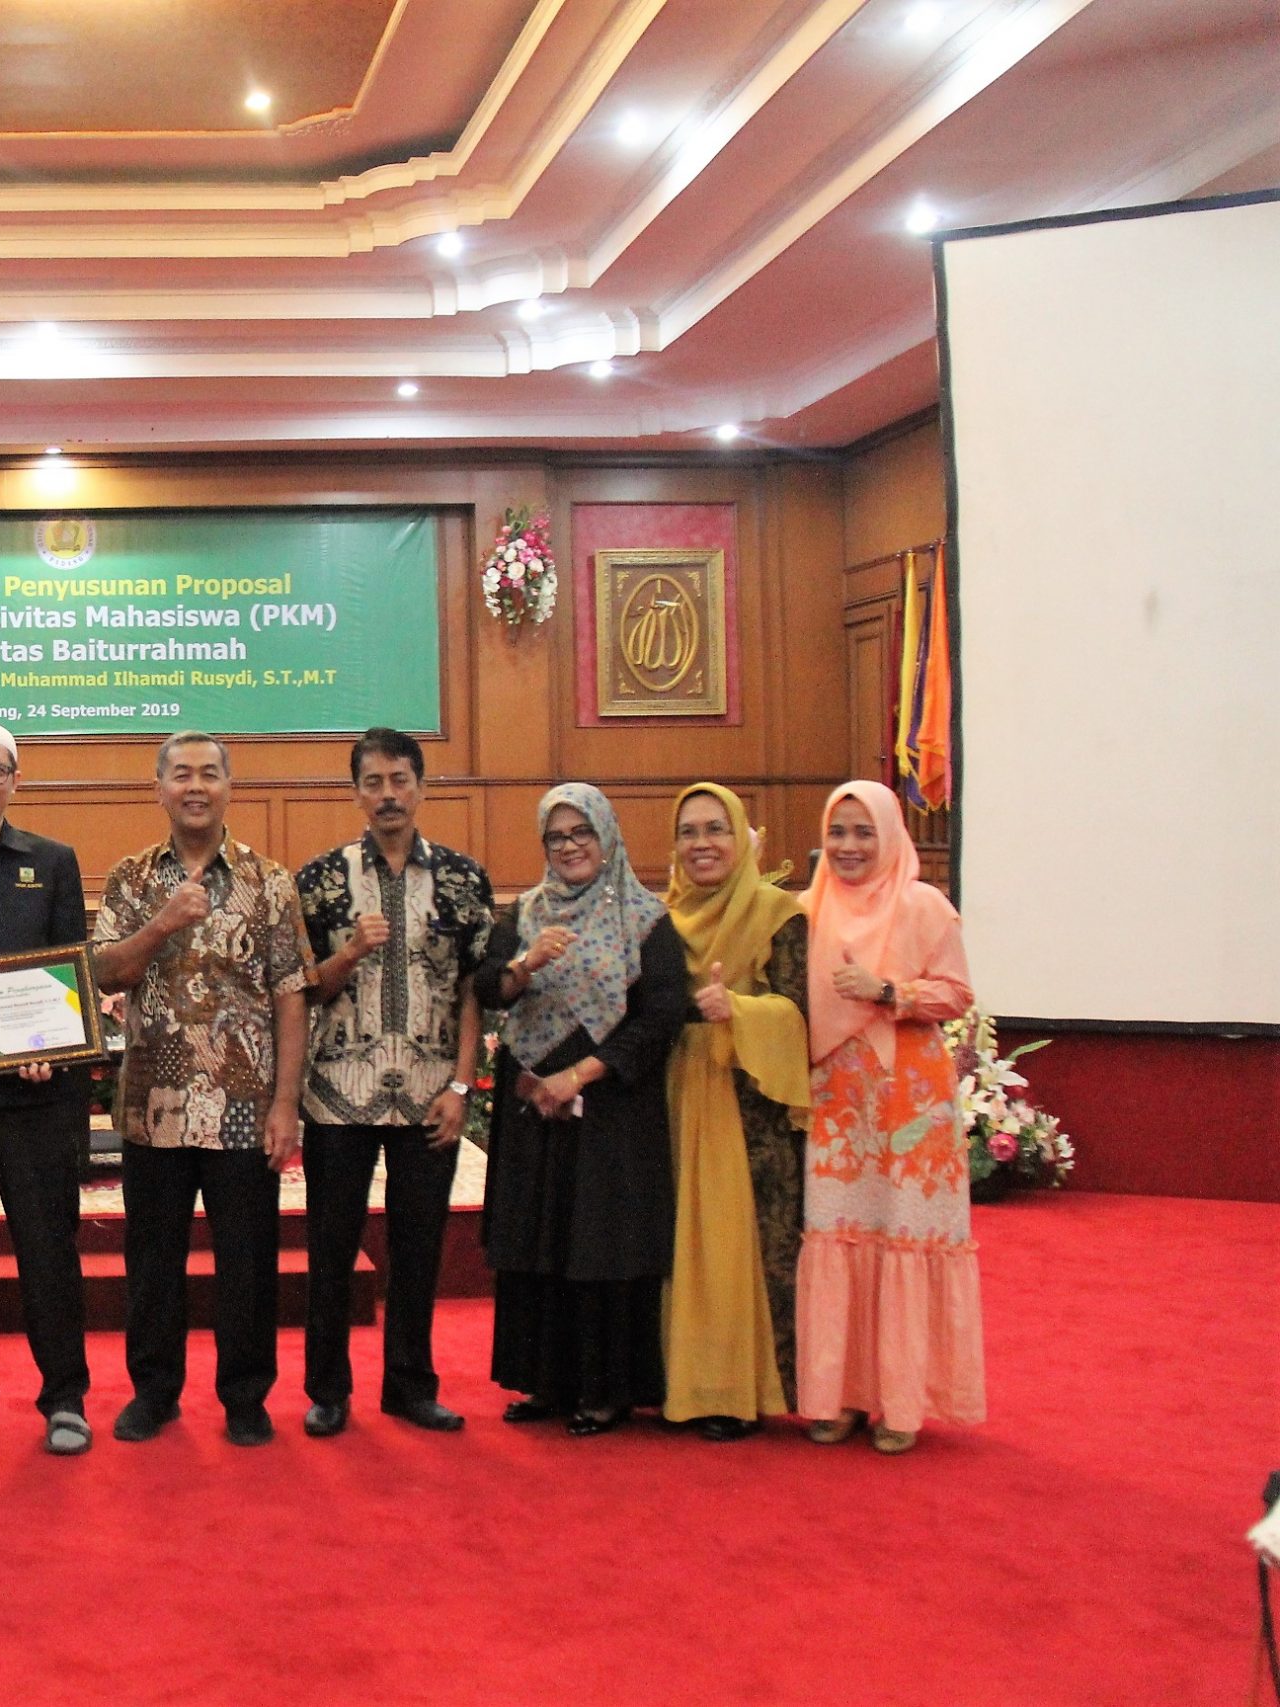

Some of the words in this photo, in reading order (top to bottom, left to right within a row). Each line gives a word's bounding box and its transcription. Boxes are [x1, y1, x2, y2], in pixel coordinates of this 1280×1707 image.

[4, 575, 167, 601] Penyusunan
[176, 573, 292, 599] Proposal
[86, 604, 240, 628] Mahasiswa
[249, 603, 337, 631] (PKM)
[52, 637, 247, 661] Baiturrahmah
[1, 672, 108, 688] Muhammad
[113, 670, 185, 686] Ilhamdi
[191, 671, 258, 689] Rusydi,
[263, 669, 337, 688] S.T.,M.T
[27, 705, 46, 718] 24
[51, 703, 136, 719] September
[141, 703, 180, 717] 2019
